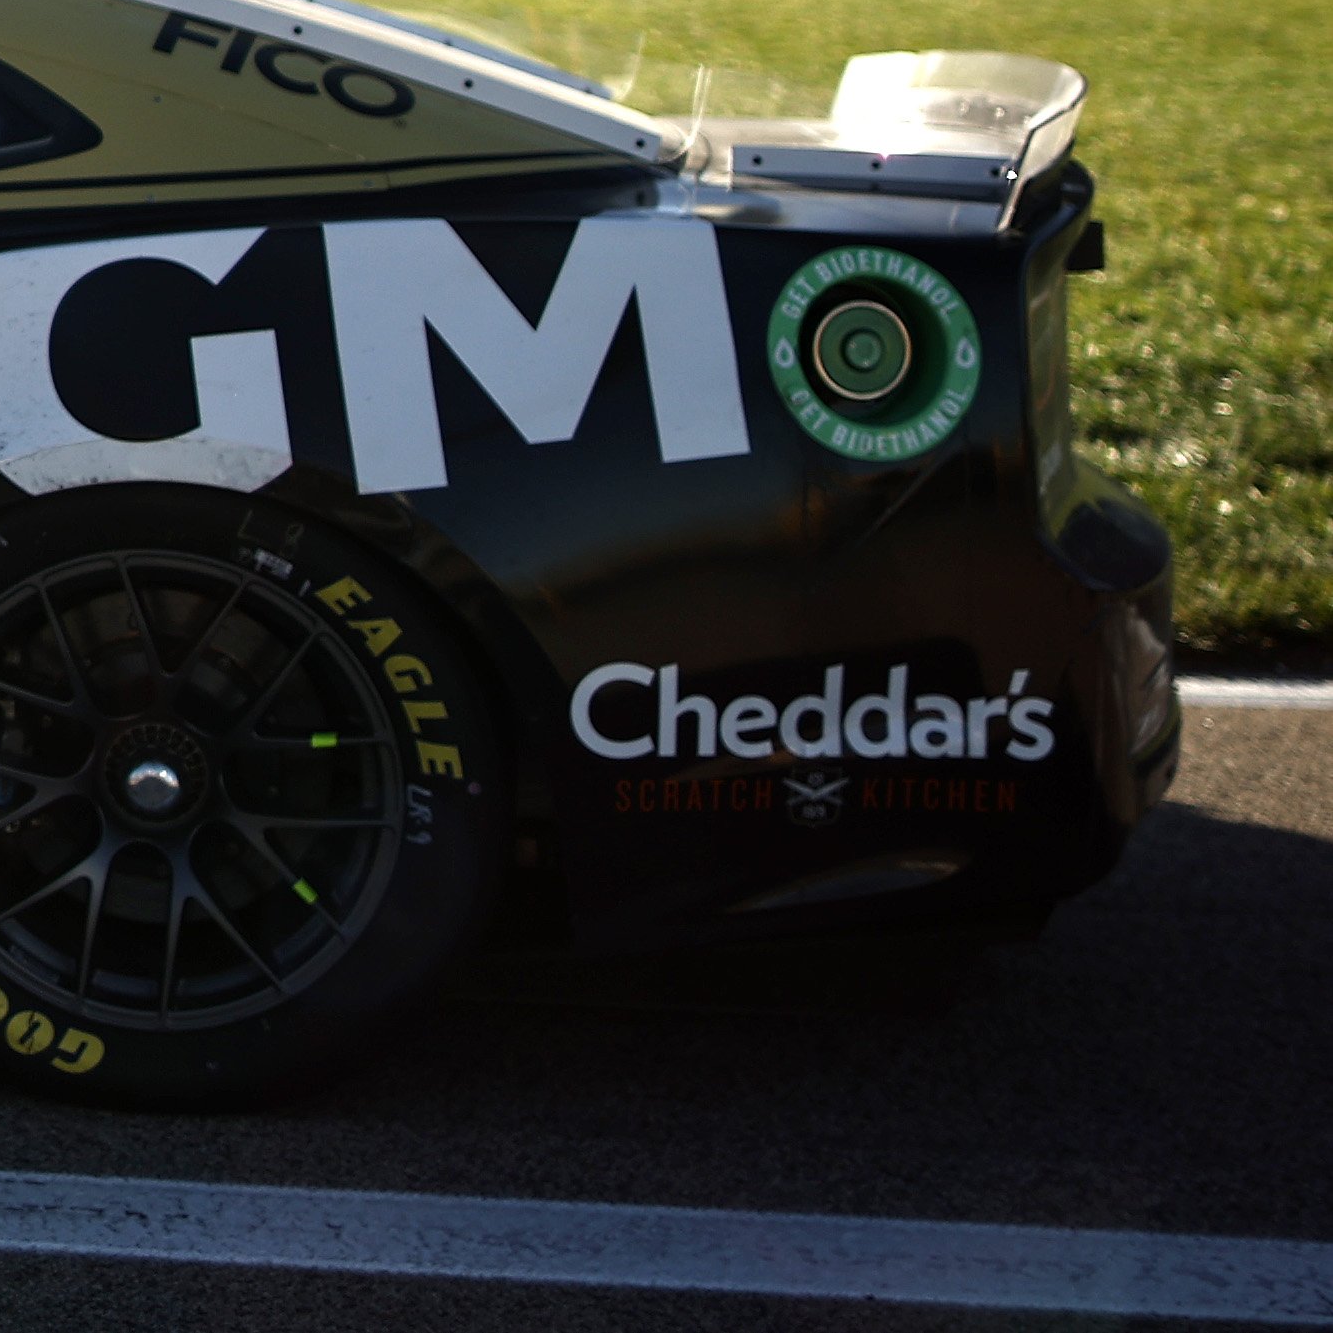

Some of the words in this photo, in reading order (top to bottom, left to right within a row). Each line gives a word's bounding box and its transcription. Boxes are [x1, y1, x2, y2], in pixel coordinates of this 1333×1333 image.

[152, 11, 415, 117] FICO
[315, 575, 464, 780] EAGLE
[569, 661, 1057, 762] Cheddar's
[614, 778, 774, 813] SCRATCH
[861, 778, 1018, 813] KITCHEN
